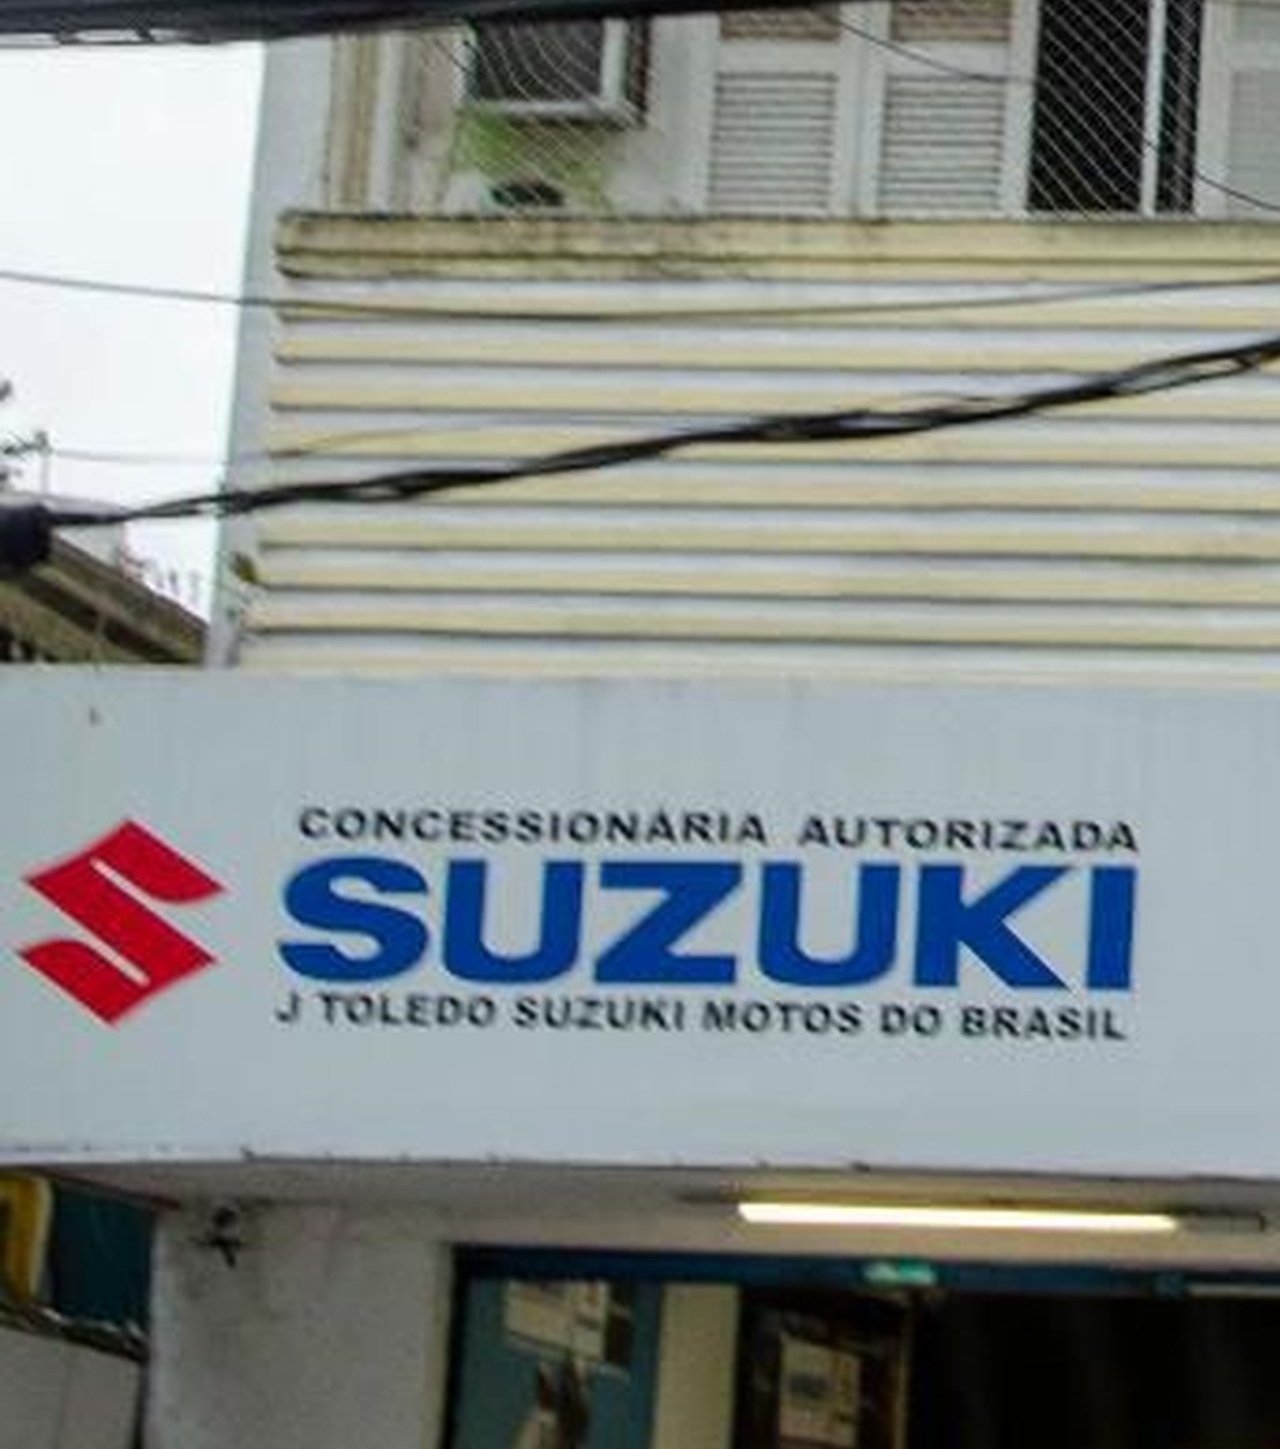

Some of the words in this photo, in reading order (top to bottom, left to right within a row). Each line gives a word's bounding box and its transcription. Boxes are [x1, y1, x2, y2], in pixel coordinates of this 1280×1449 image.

[798, 816, 1138, 852] AUTORIZADA
[277, 855, 1139, 992] SUZUKI
[277, 992, 302, 1024] J
[319, 992, 496, 1028] TOLEDO
[514, 997, 686, 1032] SUZUKI
[703, 1000, 862, 1035] MOTOS
[880, 1004, 943, 1038] DO
[961, 1006, 1126, 1042] BRASIL
